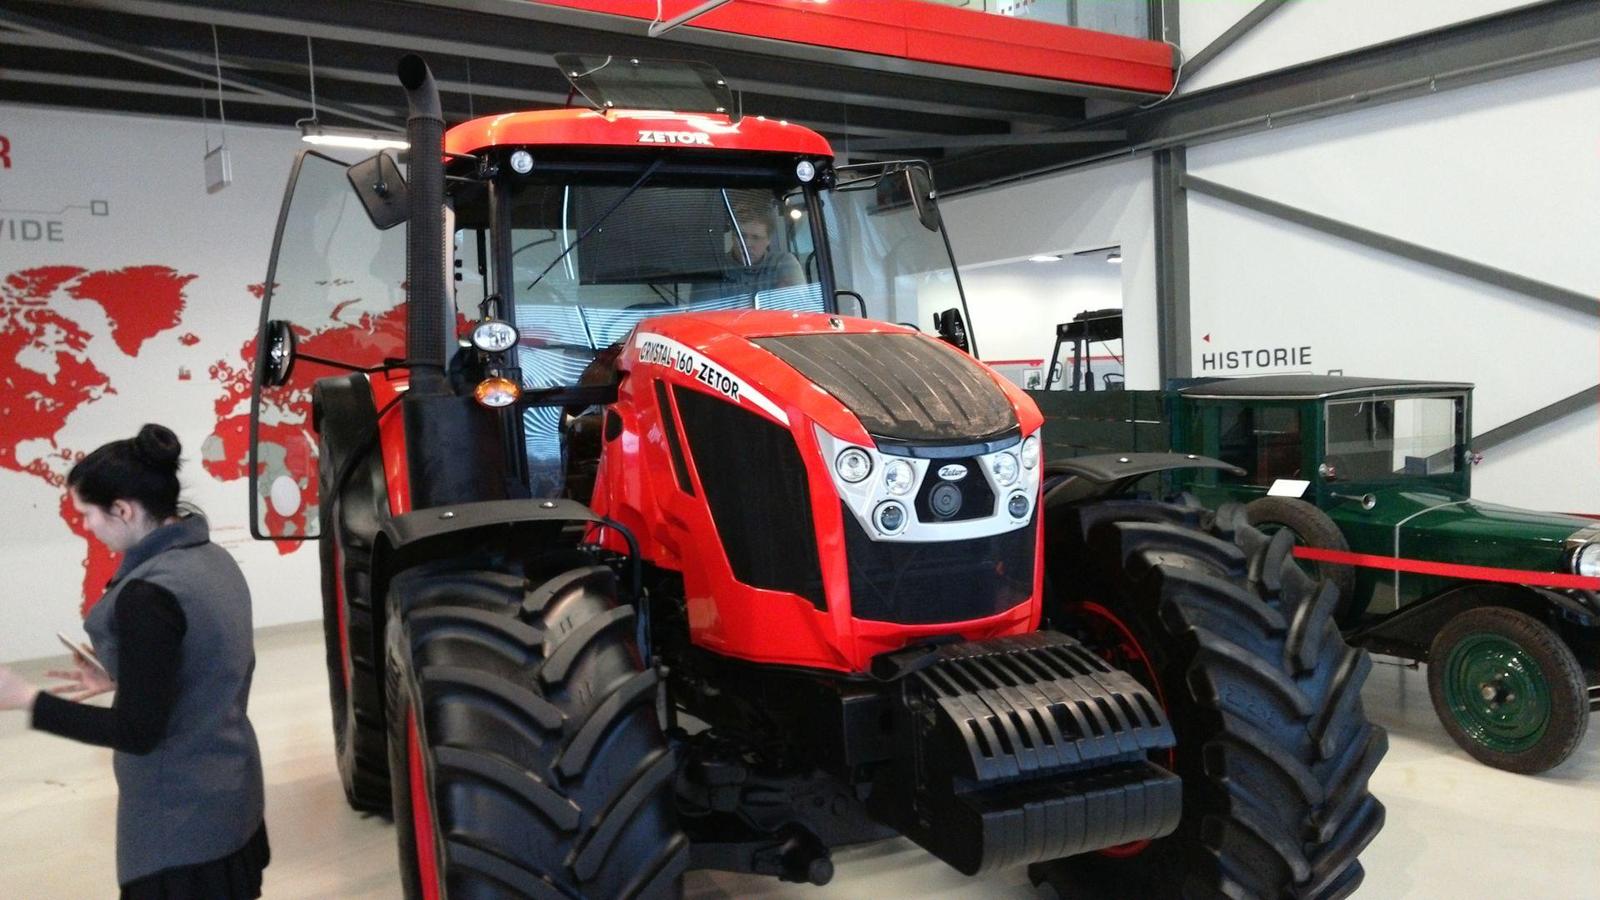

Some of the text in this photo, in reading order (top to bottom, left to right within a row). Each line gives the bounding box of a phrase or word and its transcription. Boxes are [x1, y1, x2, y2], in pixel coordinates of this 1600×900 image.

[637, 130, 714, 147] ZETOR
[0, 219, 64, 242] IDE
[1202, 346, 1312, 370] HISTORIE
[640, 341, 739, 400] CRYSTAL 160 ZETOR
[941, 467, 967, 477] Zetor
